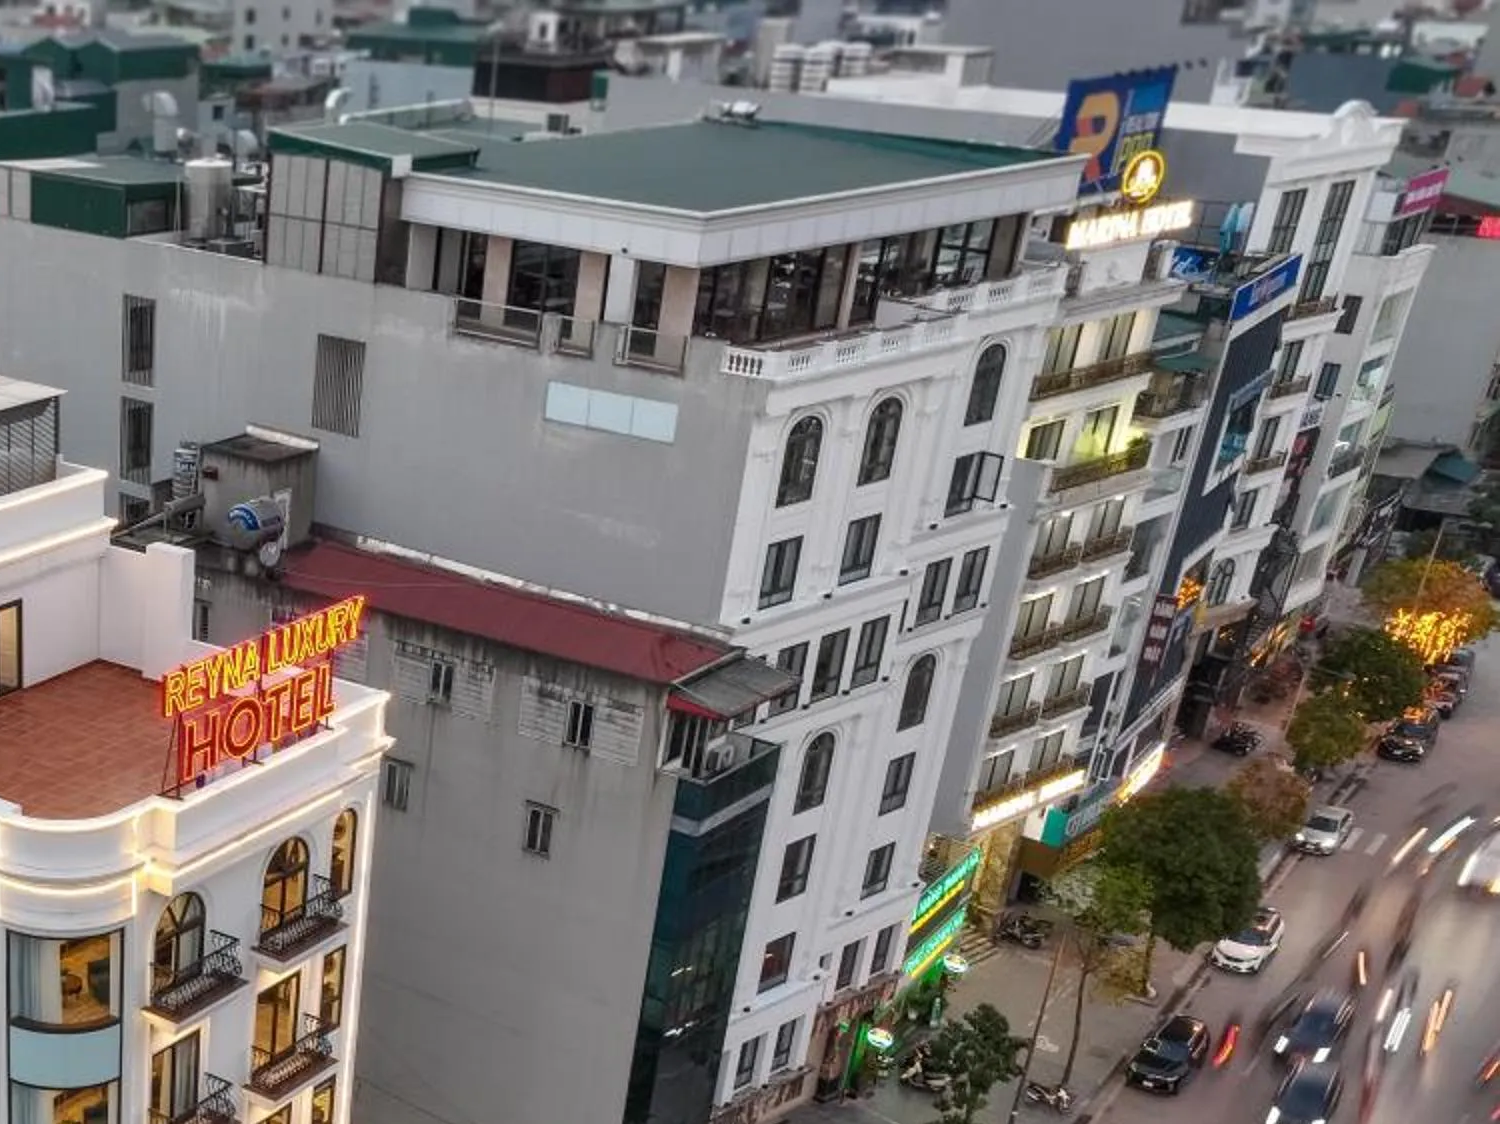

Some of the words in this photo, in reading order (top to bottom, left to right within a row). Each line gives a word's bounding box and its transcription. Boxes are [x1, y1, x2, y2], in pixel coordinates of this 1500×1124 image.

[163, 641, 261, 718] REYNA
[266, 595, 366, 674] LUXURY
[181, 663, 336, 782] HOTEL
